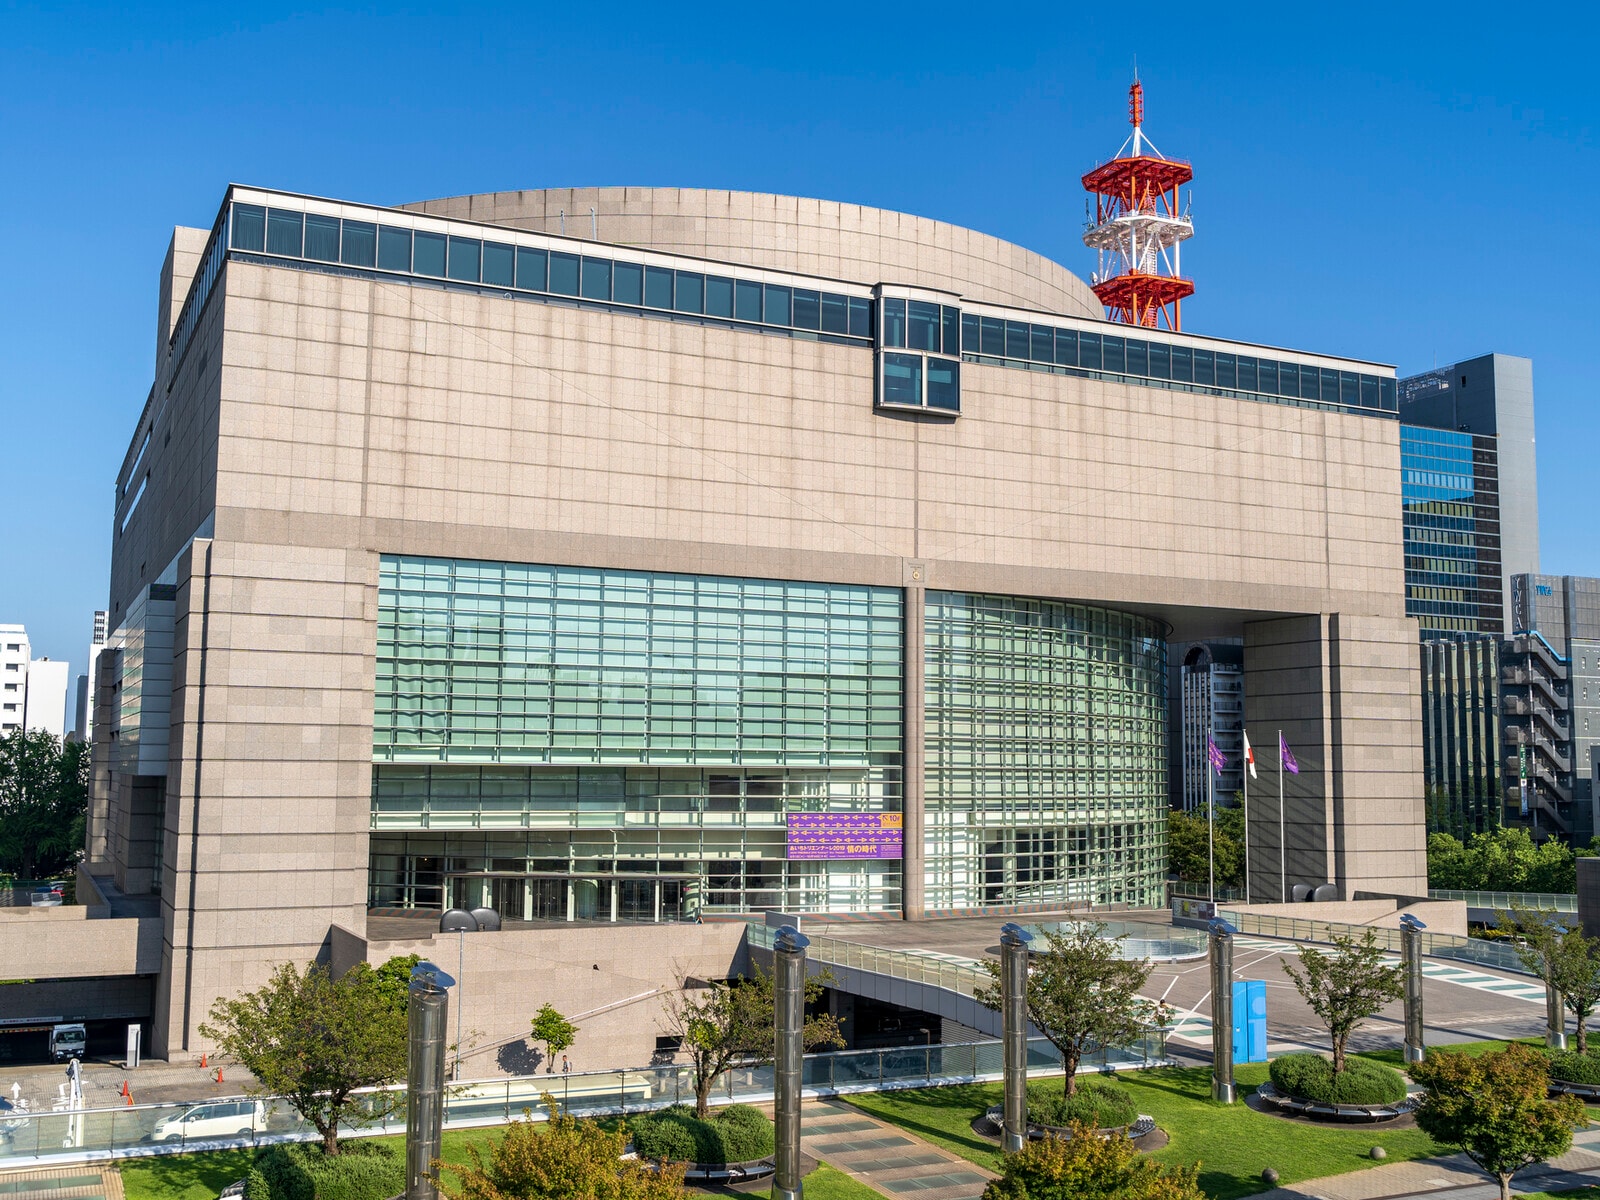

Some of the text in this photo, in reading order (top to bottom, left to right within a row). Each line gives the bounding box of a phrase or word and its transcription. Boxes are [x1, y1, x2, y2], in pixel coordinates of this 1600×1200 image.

[1513, 577, 1523, 629] YWCA
[847, 844, 877, 854] 情の時代
